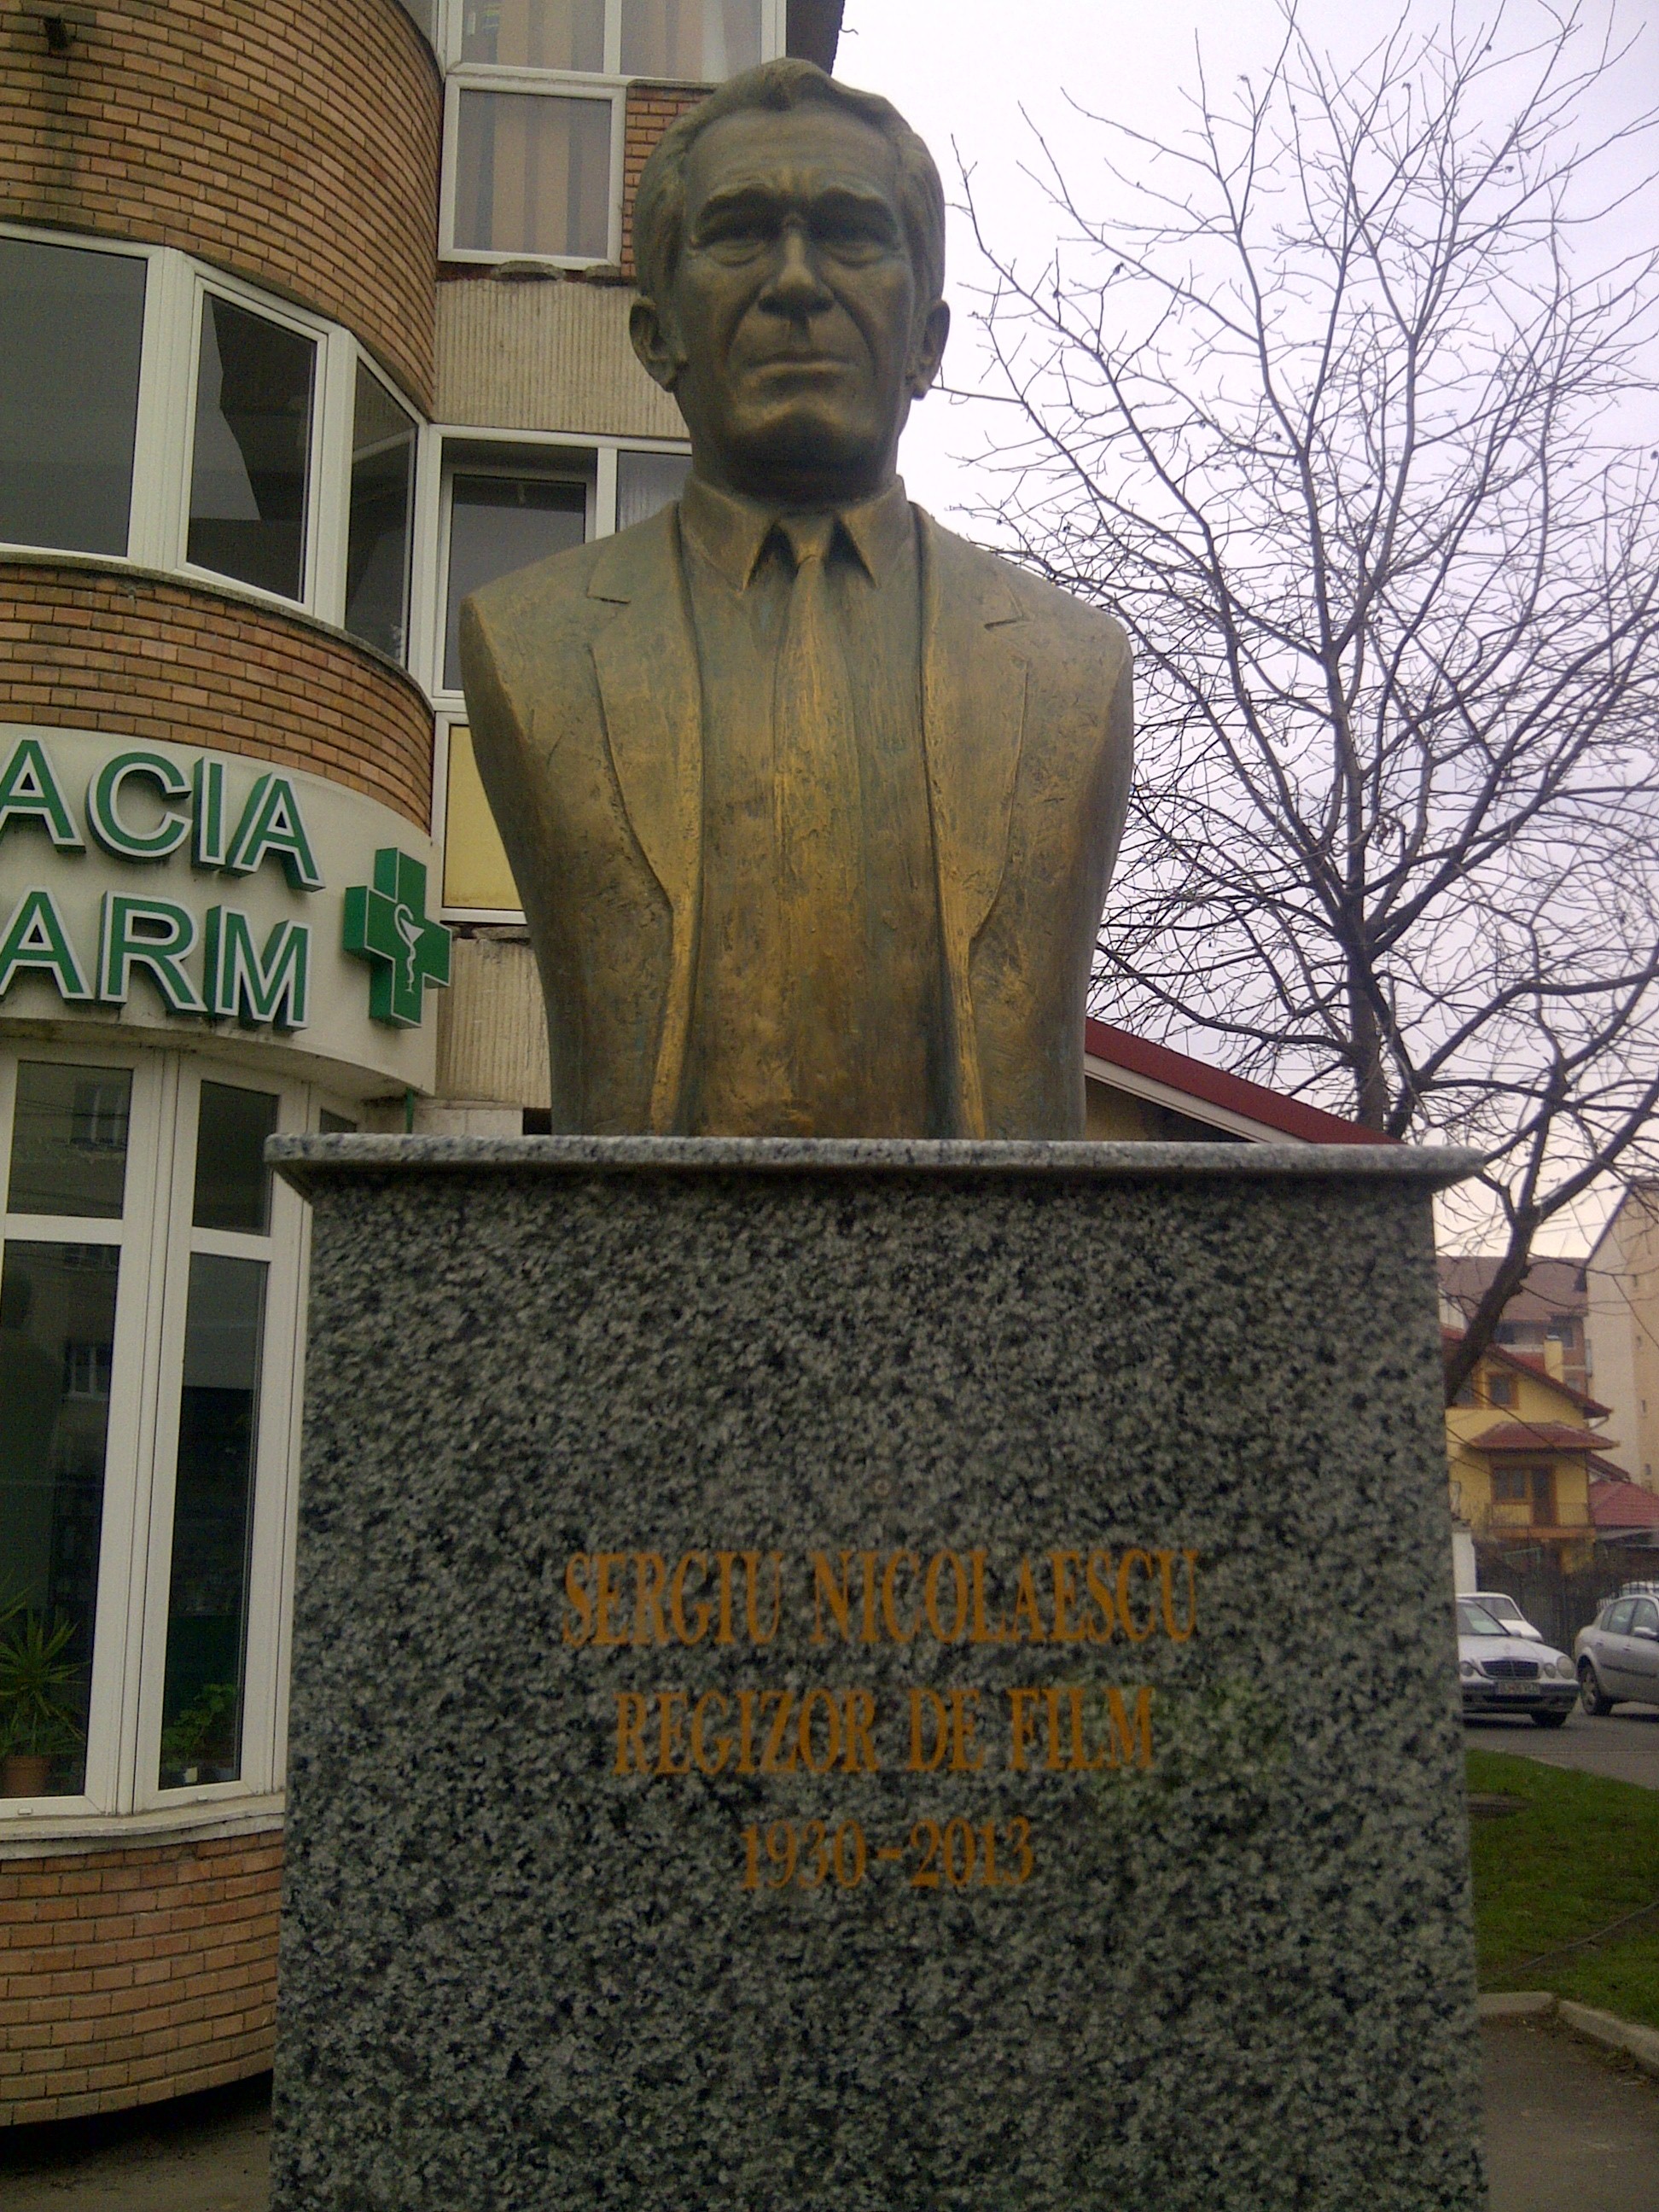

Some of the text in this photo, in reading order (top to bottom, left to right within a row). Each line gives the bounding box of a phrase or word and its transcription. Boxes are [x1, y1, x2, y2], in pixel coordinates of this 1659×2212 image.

[0, 736, 325, 892] ACIA
[0, 885, 311, 1033] ARM
[562, 1548, 1198, 1647] SERGIU NICOLAESCU
[612, 1686, 1155, 1775] REGIZOR DE FILM
[740, 1816, 1035, 1889] 1930-2013
